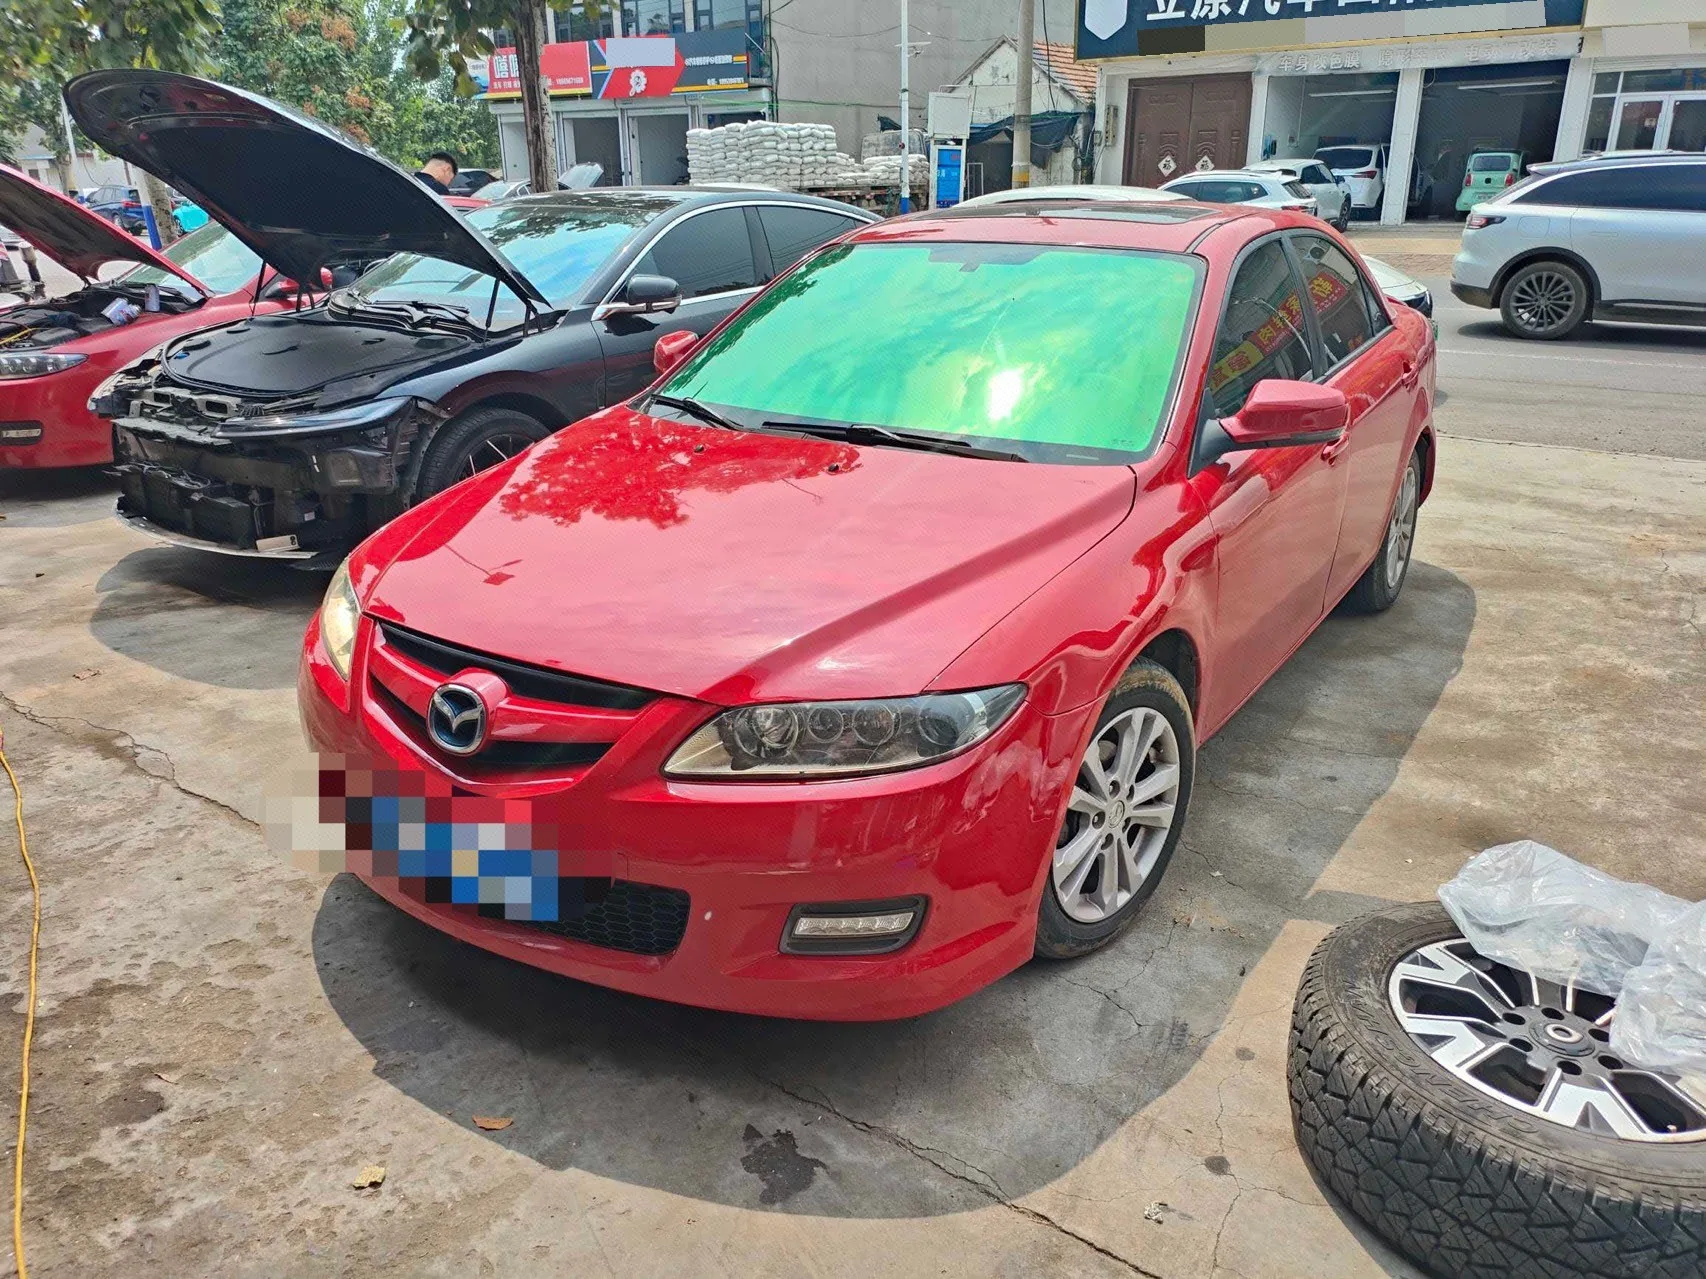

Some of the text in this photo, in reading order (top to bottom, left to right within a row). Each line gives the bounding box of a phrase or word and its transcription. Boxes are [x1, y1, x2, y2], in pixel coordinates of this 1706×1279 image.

[1278, 53, 1360, 71] 车身改色膜
